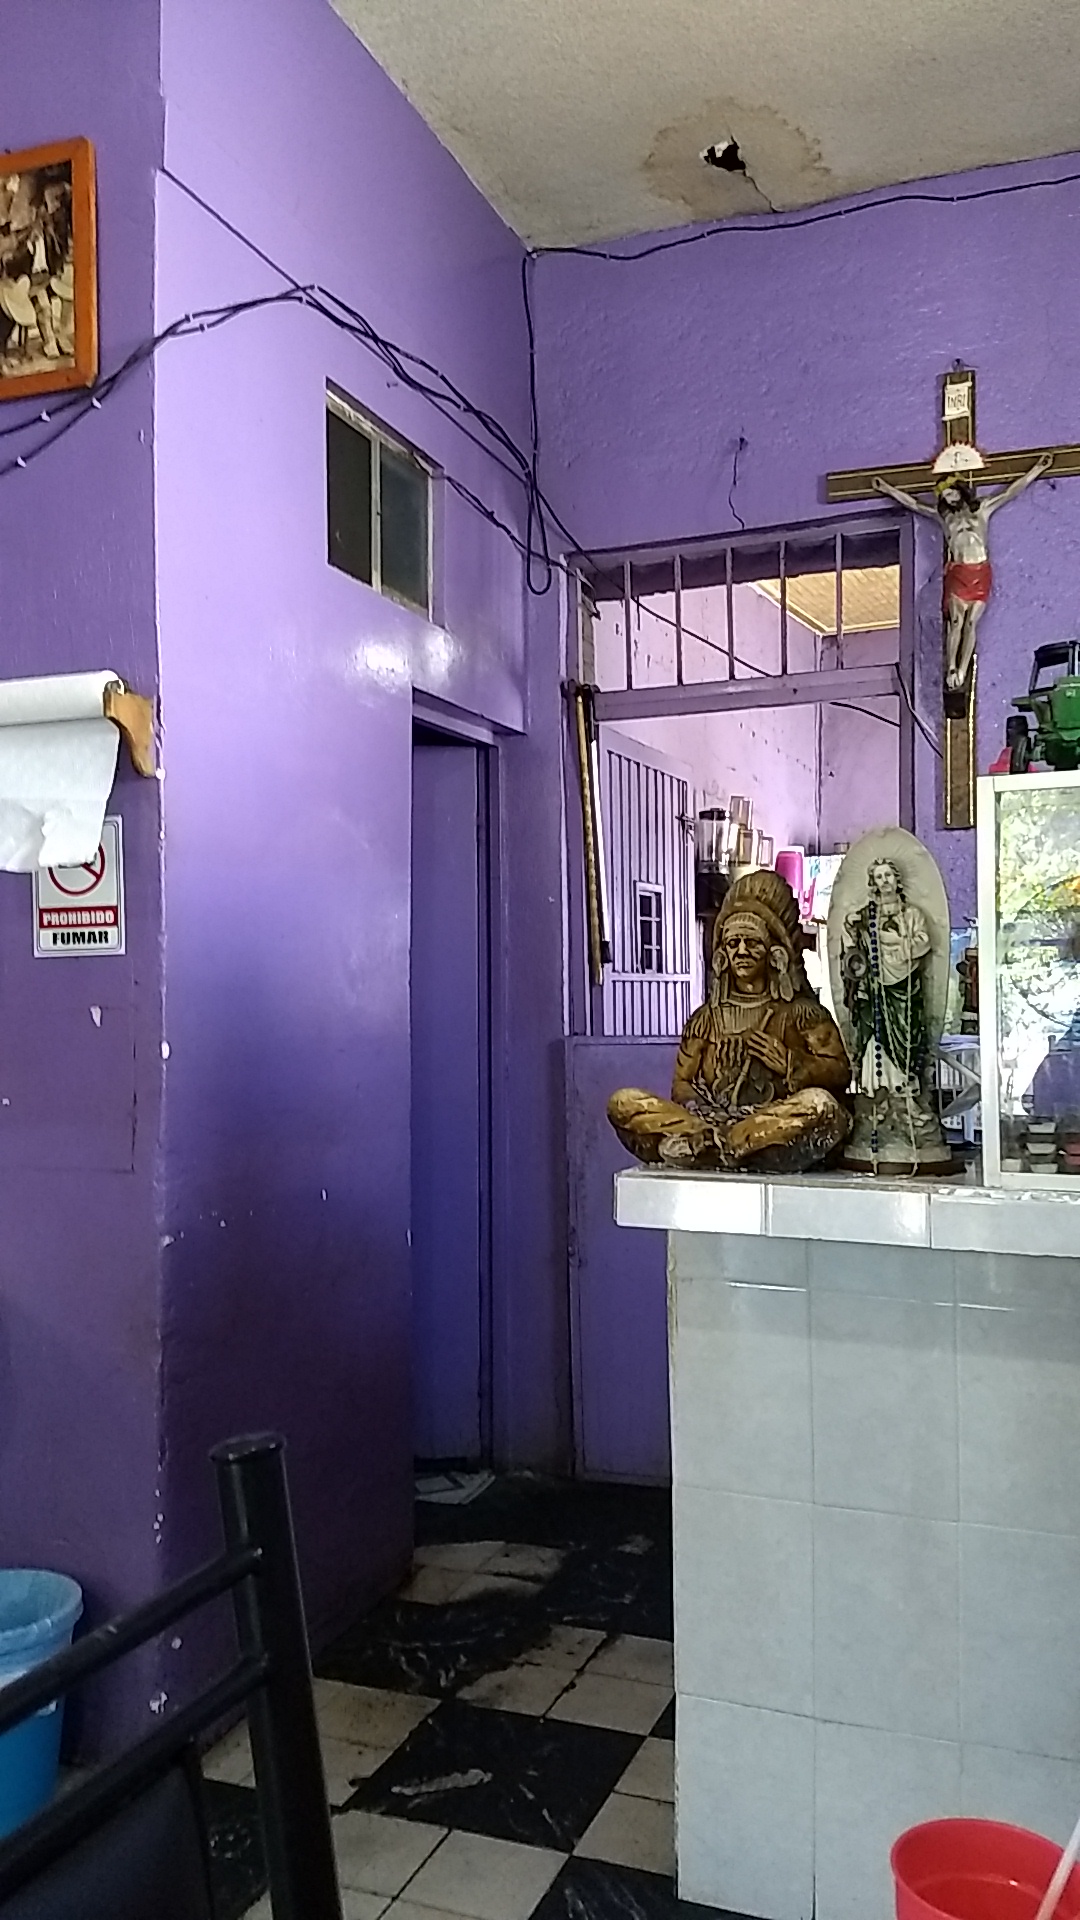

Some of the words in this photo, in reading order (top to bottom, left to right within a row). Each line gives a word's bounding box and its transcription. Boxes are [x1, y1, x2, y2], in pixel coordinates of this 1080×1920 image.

[947, 393, 966, 409] INRI
[42, 910, 115, 926] PROHIBIDO
[52, 930, 109, 946] FUMAR
